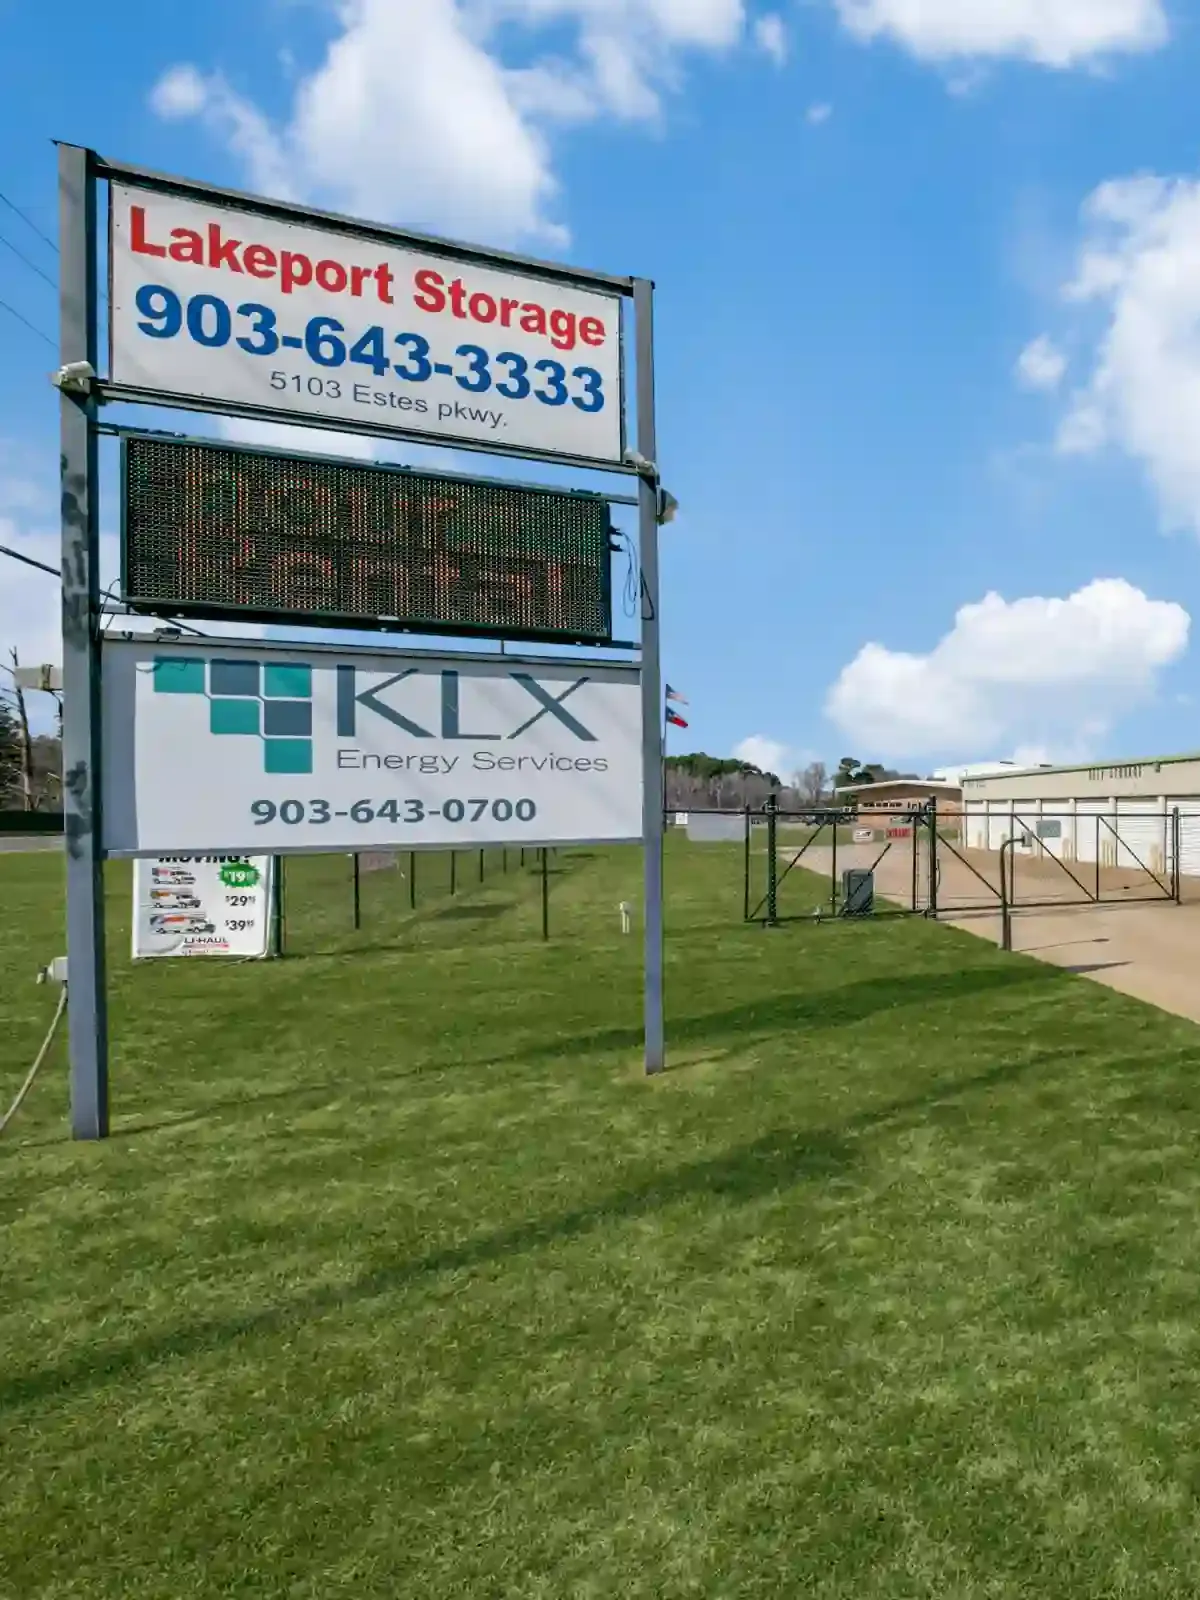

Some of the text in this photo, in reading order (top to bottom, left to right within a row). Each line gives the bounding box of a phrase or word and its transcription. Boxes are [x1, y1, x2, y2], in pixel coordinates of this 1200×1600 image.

[130, 204, 606, 350] Lakeport Storage
[135, 284, 605, 412] 903-643-3333
[270, 371, 508, 427] 5103 Estes pkwy.
[337, 664, 599, 741] KLX
[337, 750, 609, 774] Energy Services
[250, 798, 537, 825] 903-643-0700
